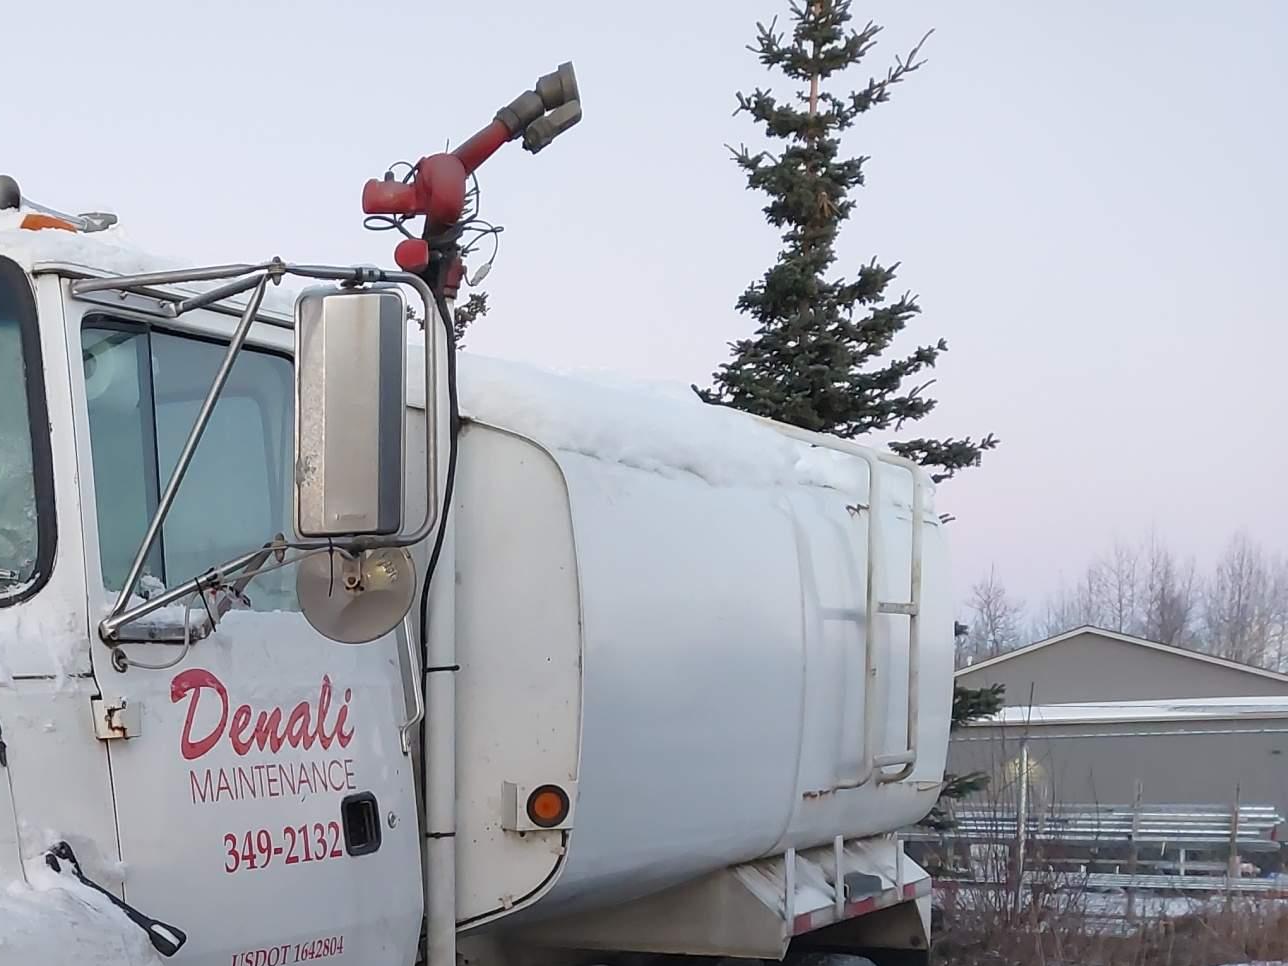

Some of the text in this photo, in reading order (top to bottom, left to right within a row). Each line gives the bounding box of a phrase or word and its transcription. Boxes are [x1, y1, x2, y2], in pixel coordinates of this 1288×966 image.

[170, 667, 355, 760] Denali
[189, 758, 357, 804] MAINTENANCE
[223, 820, 344, 874] 349-2132
[293, 935, 344, 963] 1642804
